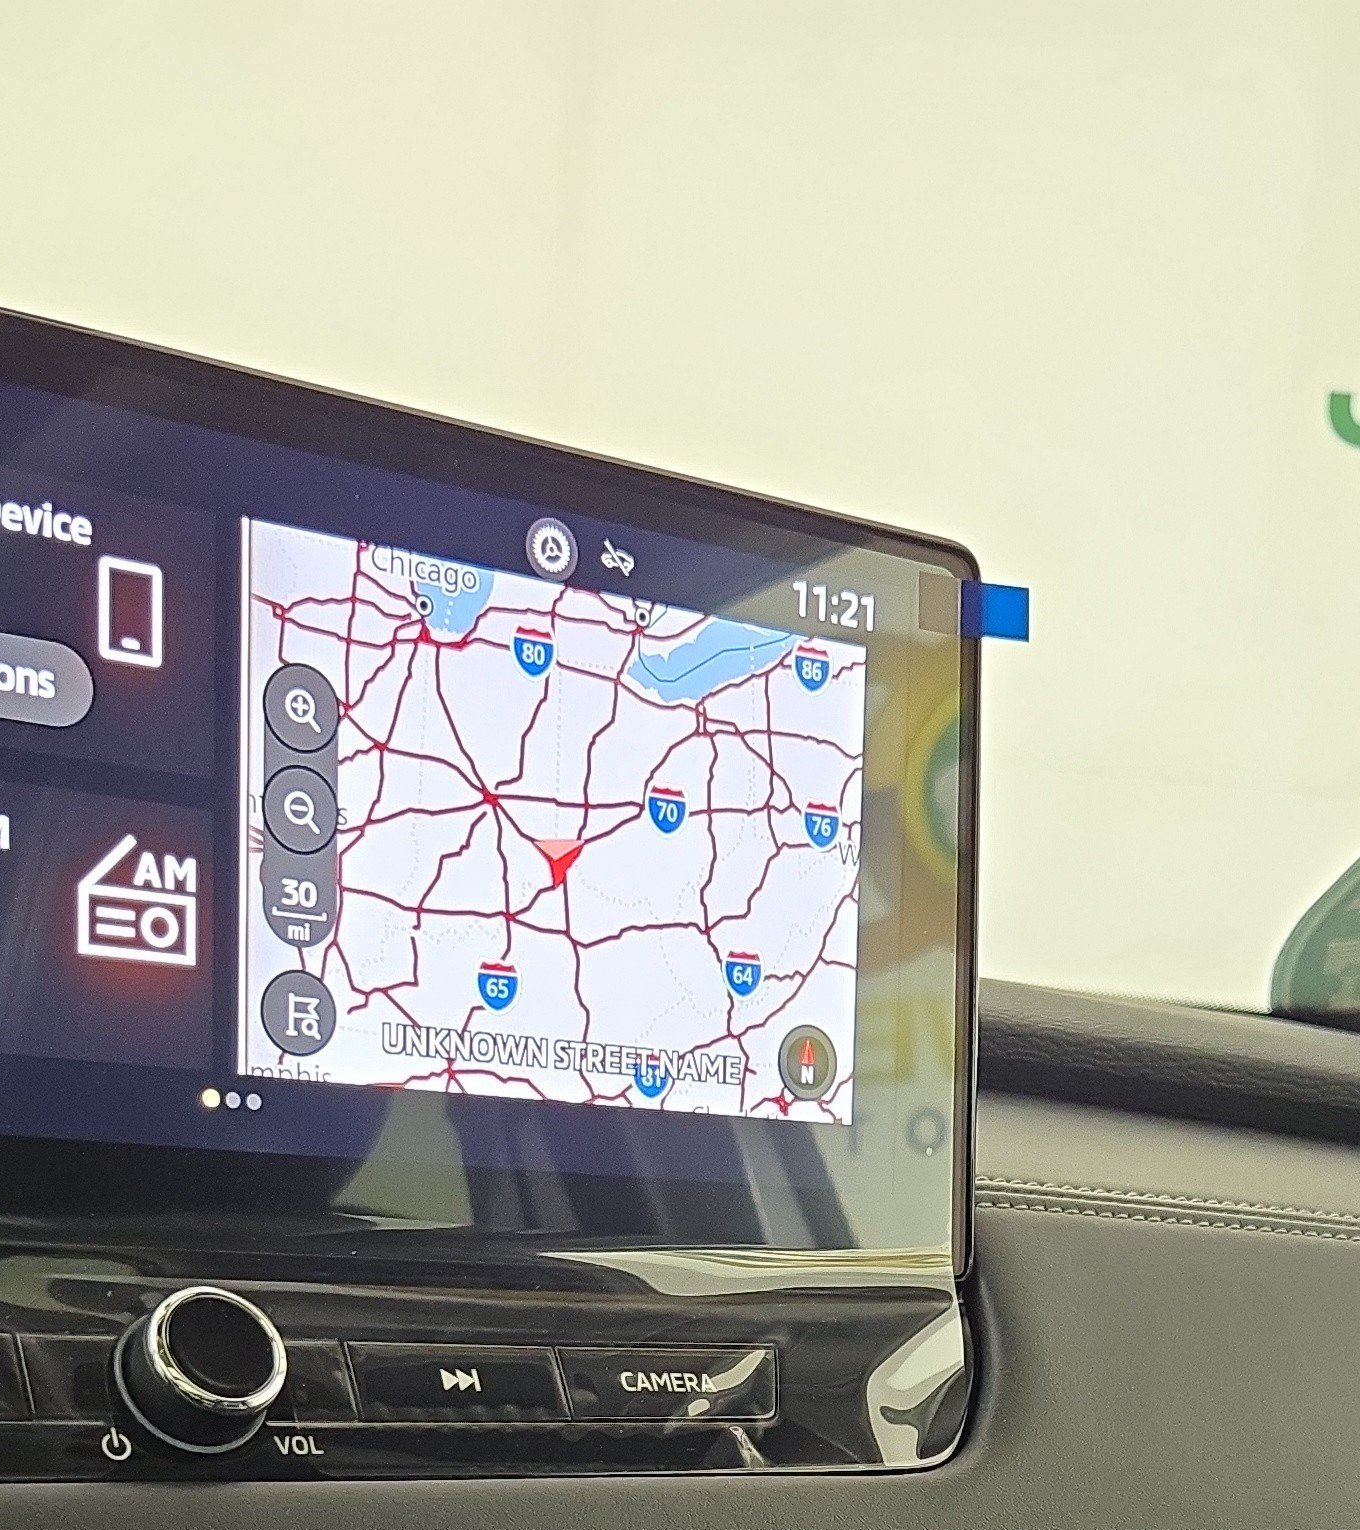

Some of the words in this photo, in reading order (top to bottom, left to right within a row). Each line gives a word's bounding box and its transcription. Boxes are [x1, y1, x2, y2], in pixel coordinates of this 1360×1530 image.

[371, 541, 477, 594] Chicago
[792, 581, 876, 632] 11:21
[521, 641, 546, 667] 80
[801, 658, 823, 682] 86
[655, 799, 679, 825] 70
[811, 816, 832, 838] 76
[133, 852, 197, 892] AM
[281, 878, 318, 908] 30
[287, 922, 311, 942] mi
[732, 964, 754, 987] 64
[486, 976, 510, 1001] 65
[382, 1022, 549, 1068] UNKNOWN
[553, 1042, 654, 1077] STREET
[659, 1050, 742, 1086] NAME
[800, 1066, 814, 1085] N
[620, 1370, 717, 1394] CAMERA
[273, 1436, 324, 1457] VOL
